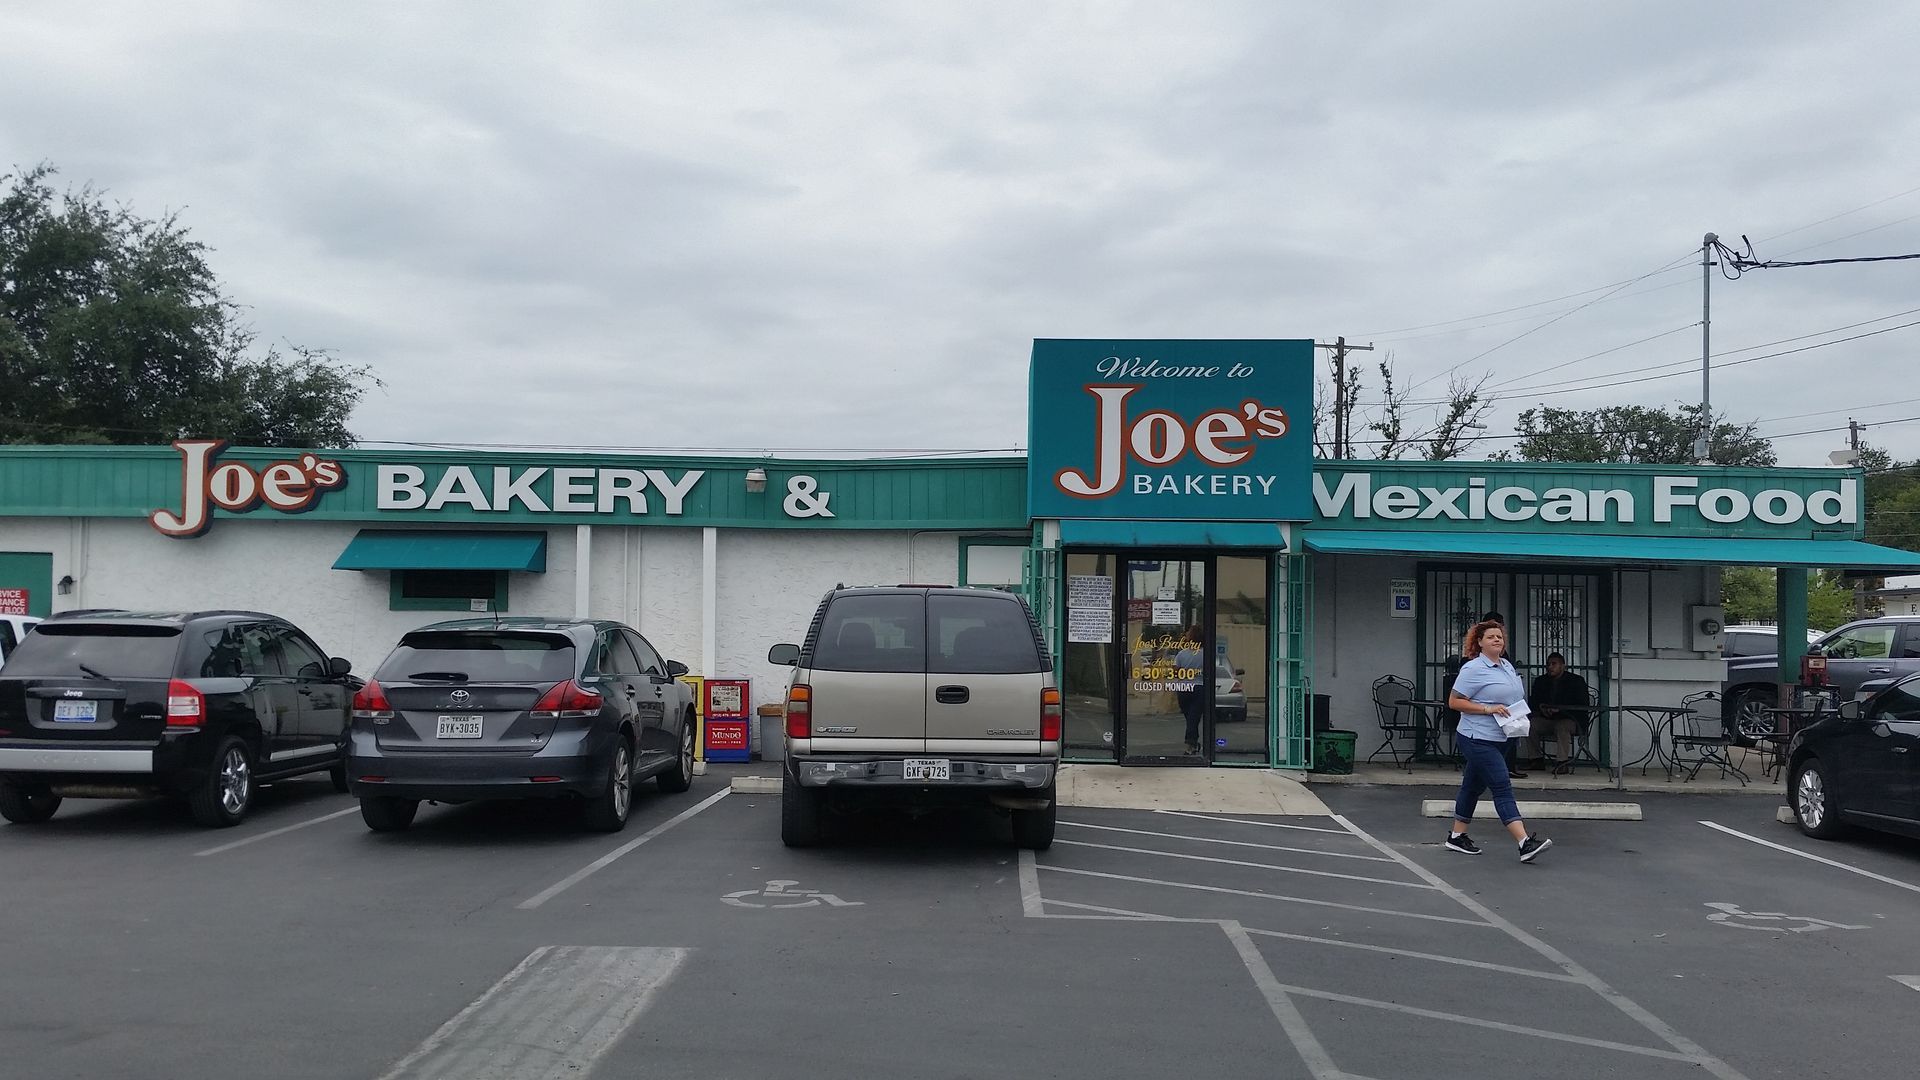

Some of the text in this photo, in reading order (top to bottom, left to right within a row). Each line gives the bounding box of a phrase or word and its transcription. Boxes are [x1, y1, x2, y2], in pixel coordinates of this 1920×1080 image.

[1096, 356, 1254, 379] Welcome to
[1056, 383, 1288, 496] Joe's
[150, 440, 837, 535] Joe's BAKERY &
[1132, 475, 1277, 496] BAKERY
[1312, 472, 1857, 525] Mexican Food
[1132, 633, 1202, 657] Joe's Bakery
[63, 689, 84, 697] Jeep
[1133, 682, 1196, 692] CLOSED MONDAY
[986, 728, 1037, 736] CHEVROLET
